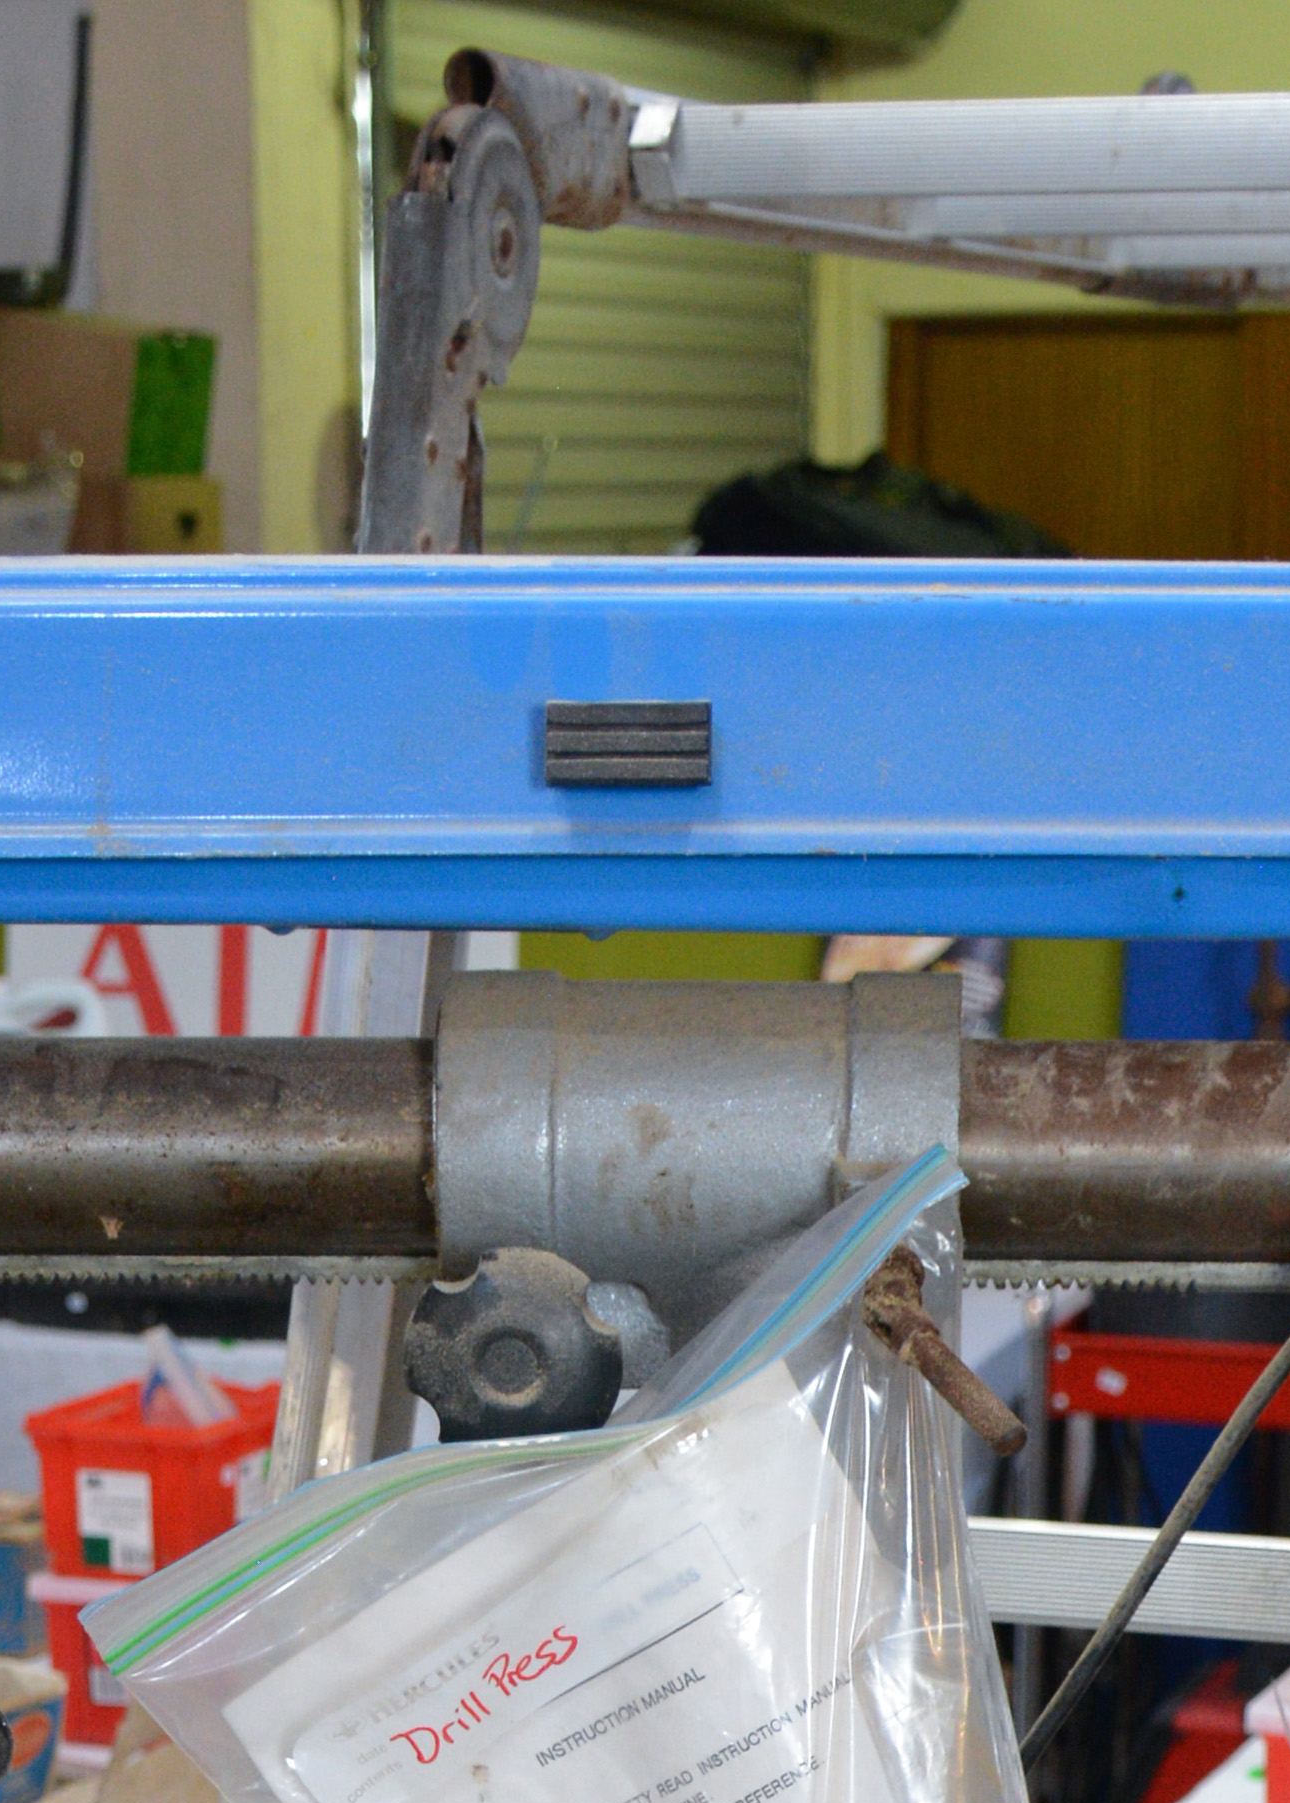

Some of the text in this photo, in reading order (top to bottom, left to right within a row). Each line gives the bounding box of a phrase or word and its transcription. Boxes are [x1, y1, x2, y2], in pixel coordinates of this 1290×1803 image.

[367, 1628, 501, 1725] HERCULES
[390, 1625, 579, 1764] Drill Press
[535, 1667, 707, 1768] INSTRUCTION MANUAL
[656, 1770, 694, 1798] READ
[697, 1711, 793, 1775] INSTRUCTION
